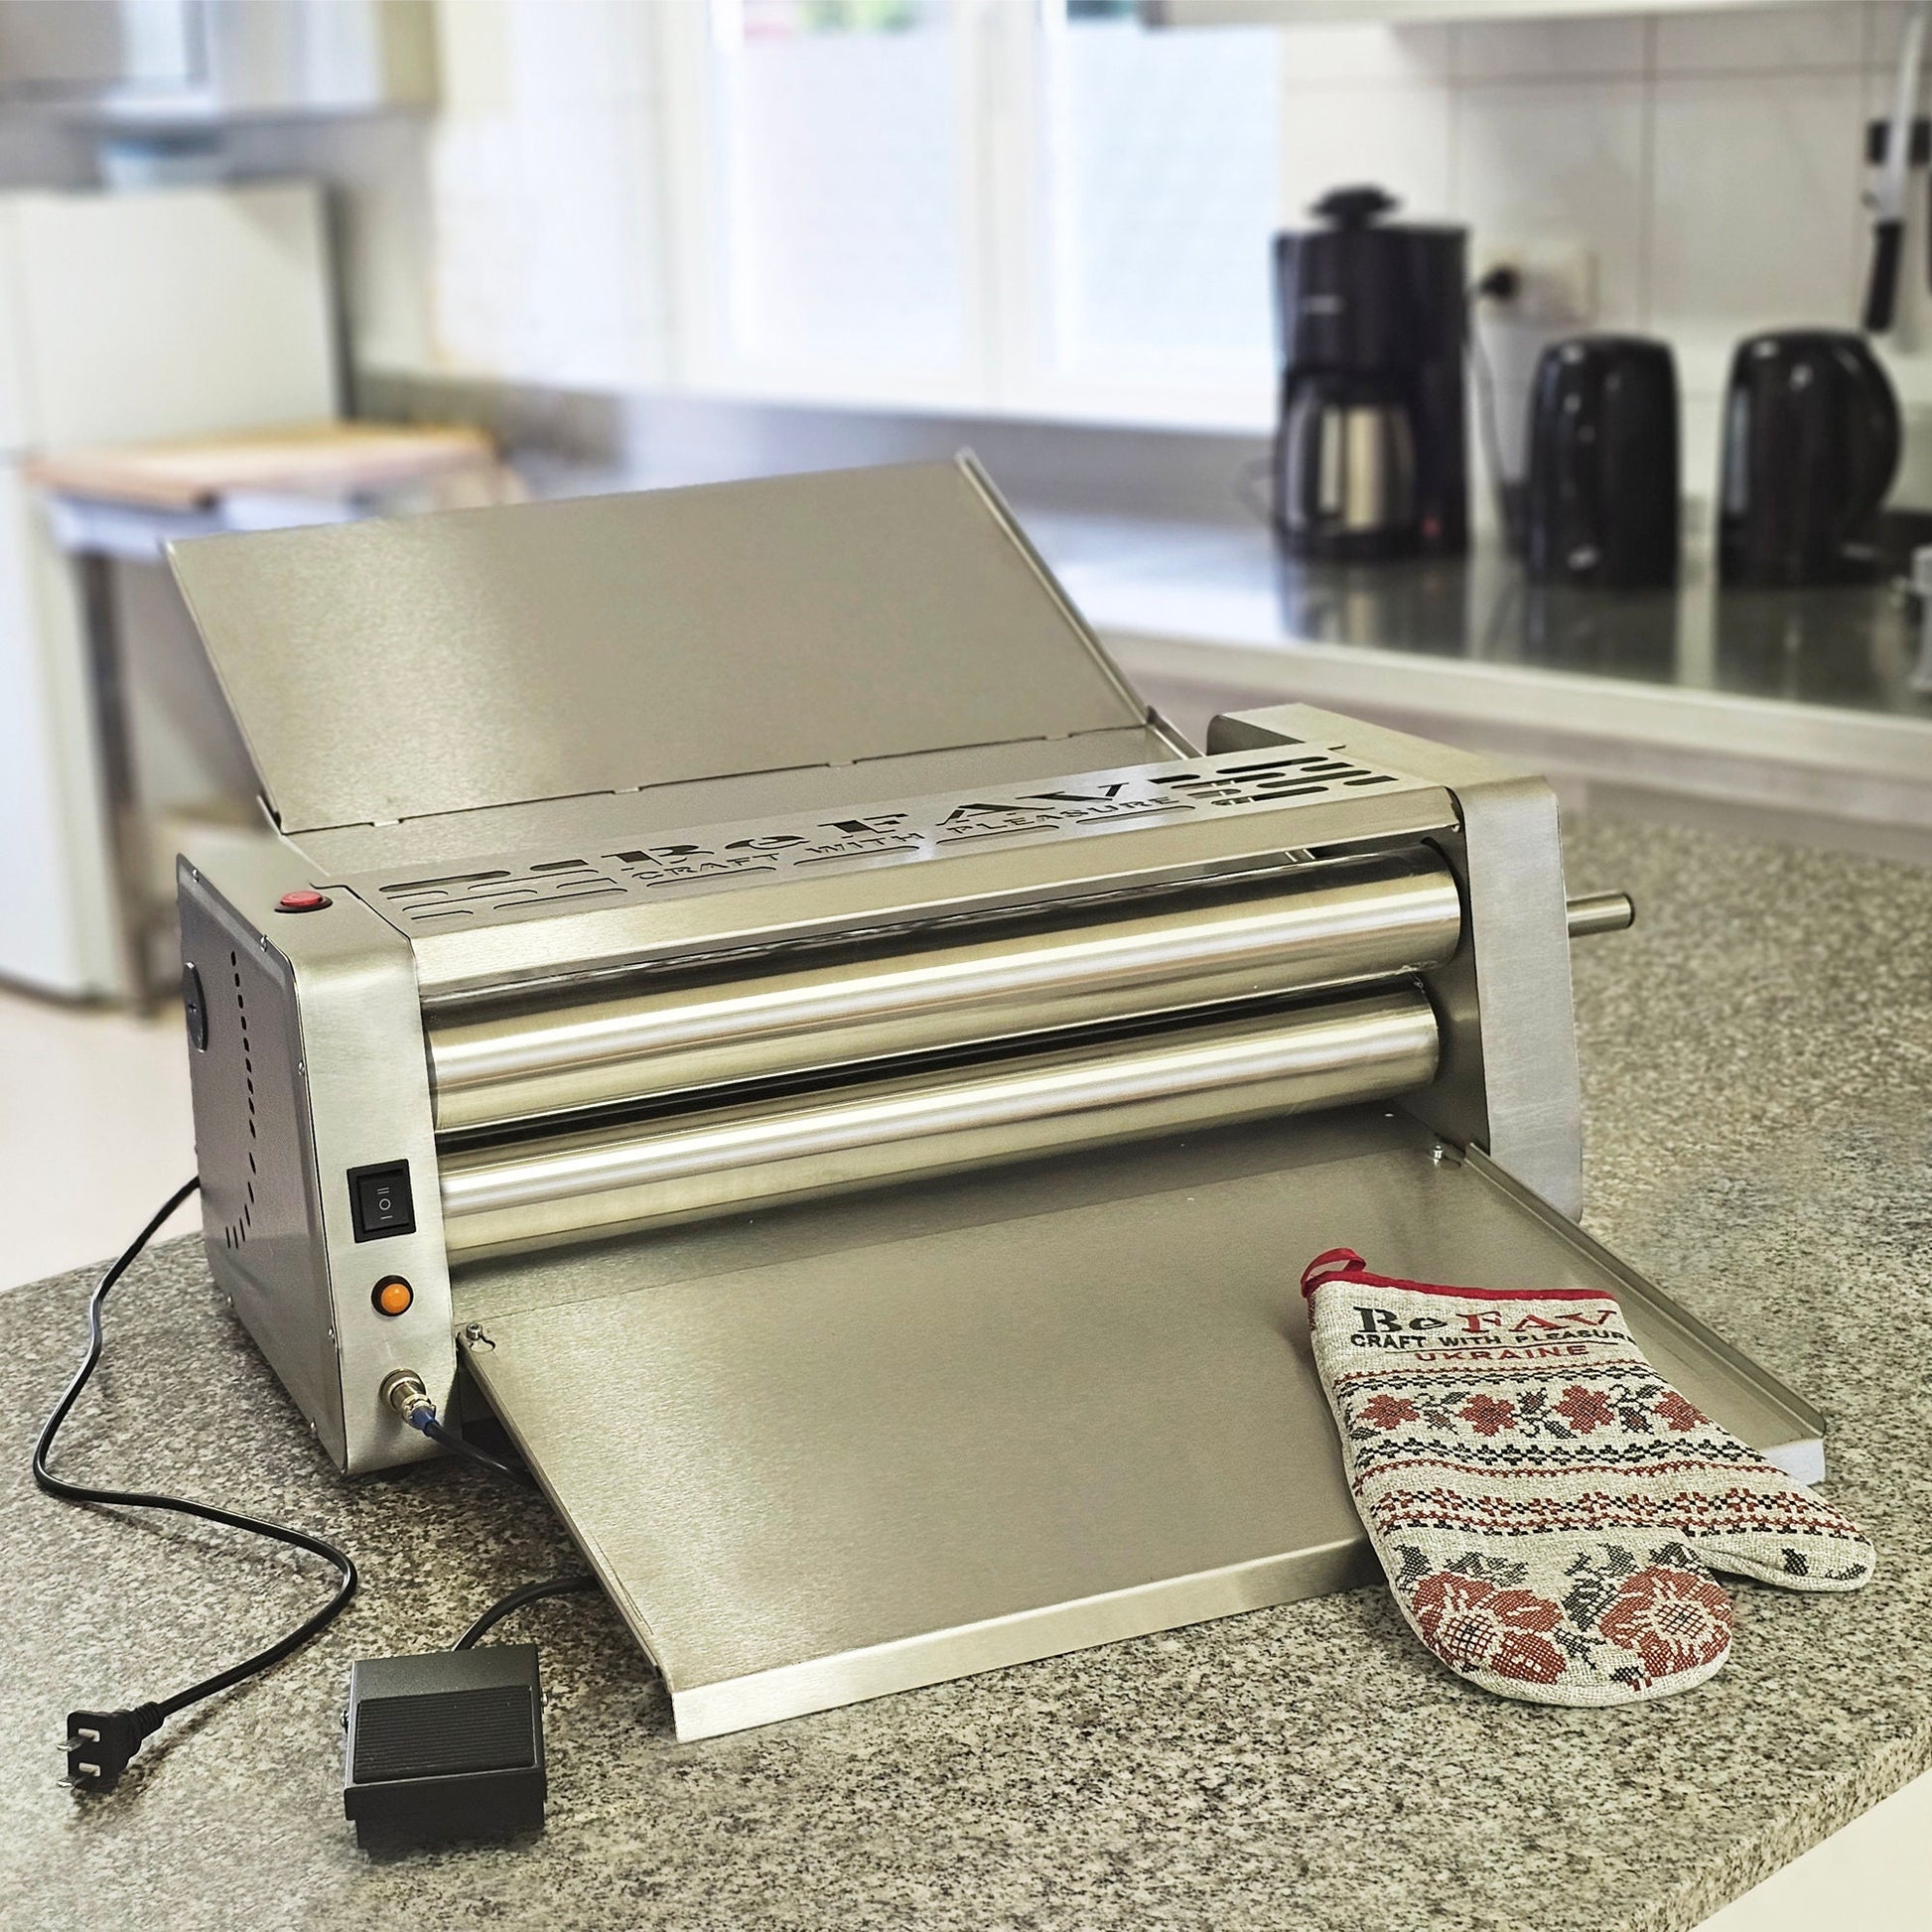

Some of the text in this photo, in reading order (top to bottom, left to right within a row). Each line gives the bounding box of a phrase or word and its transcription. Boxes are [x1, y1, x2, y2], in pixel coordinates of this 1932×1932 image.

[631, 795, 1180, 881] CRAFT WITH PLEASURE
[1350, 1328, 1637, 1350] CRAFT WITH PLEASUR
[1414, 1344, 1590, 1362] UKRAINE
